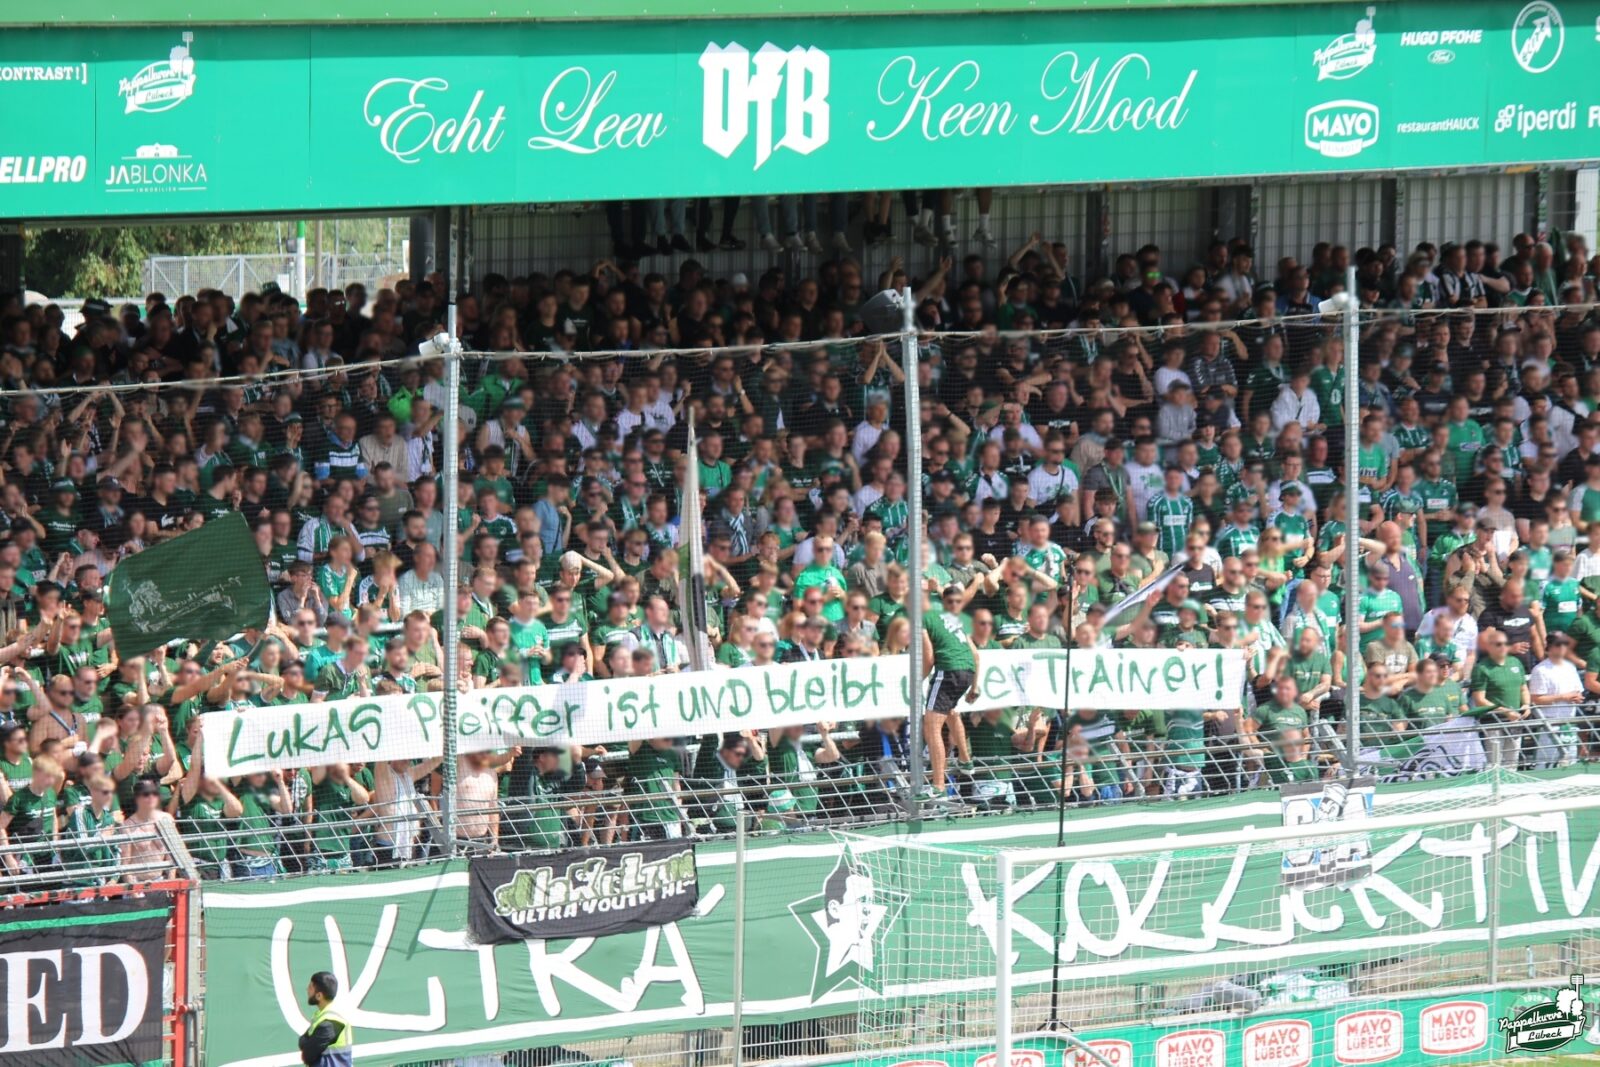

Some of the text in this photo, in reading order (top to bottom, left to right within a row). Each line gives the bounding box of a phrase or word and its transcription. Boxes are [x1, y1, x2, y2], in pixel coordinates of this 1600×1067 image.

[1400, 31, 1439, 47] HUGO
[866, 50, 1199, 142] Keen Mood
[363, 65, 668, 164] Echt Leev
[1312, 112, 1372, 138] MAYO
[1517, 101, 1577, 139] iperdi
[0, 155, 88, 184] ELLPRO
[105, 163, 208, 185] JABLONKA
[603, 684, 661, 732] ist
[511, 902, 578, 925] ULTRA
[0, 943, 149, 1052] ED
[1346, 1017, 1392, 1037] MAYO
[1431, 1009, 1477, 1029] MAYO
[1254, 1027, 1301, 1048] MAYO
[1346, 1034, 1392, 1051] LÜBECK
[1431, 1026, 1476, 1043] LÜBECK
[1167, 1037, 1215, 1057] MAYO
[1254, 1044, 1300, 1062] LÜBECK
